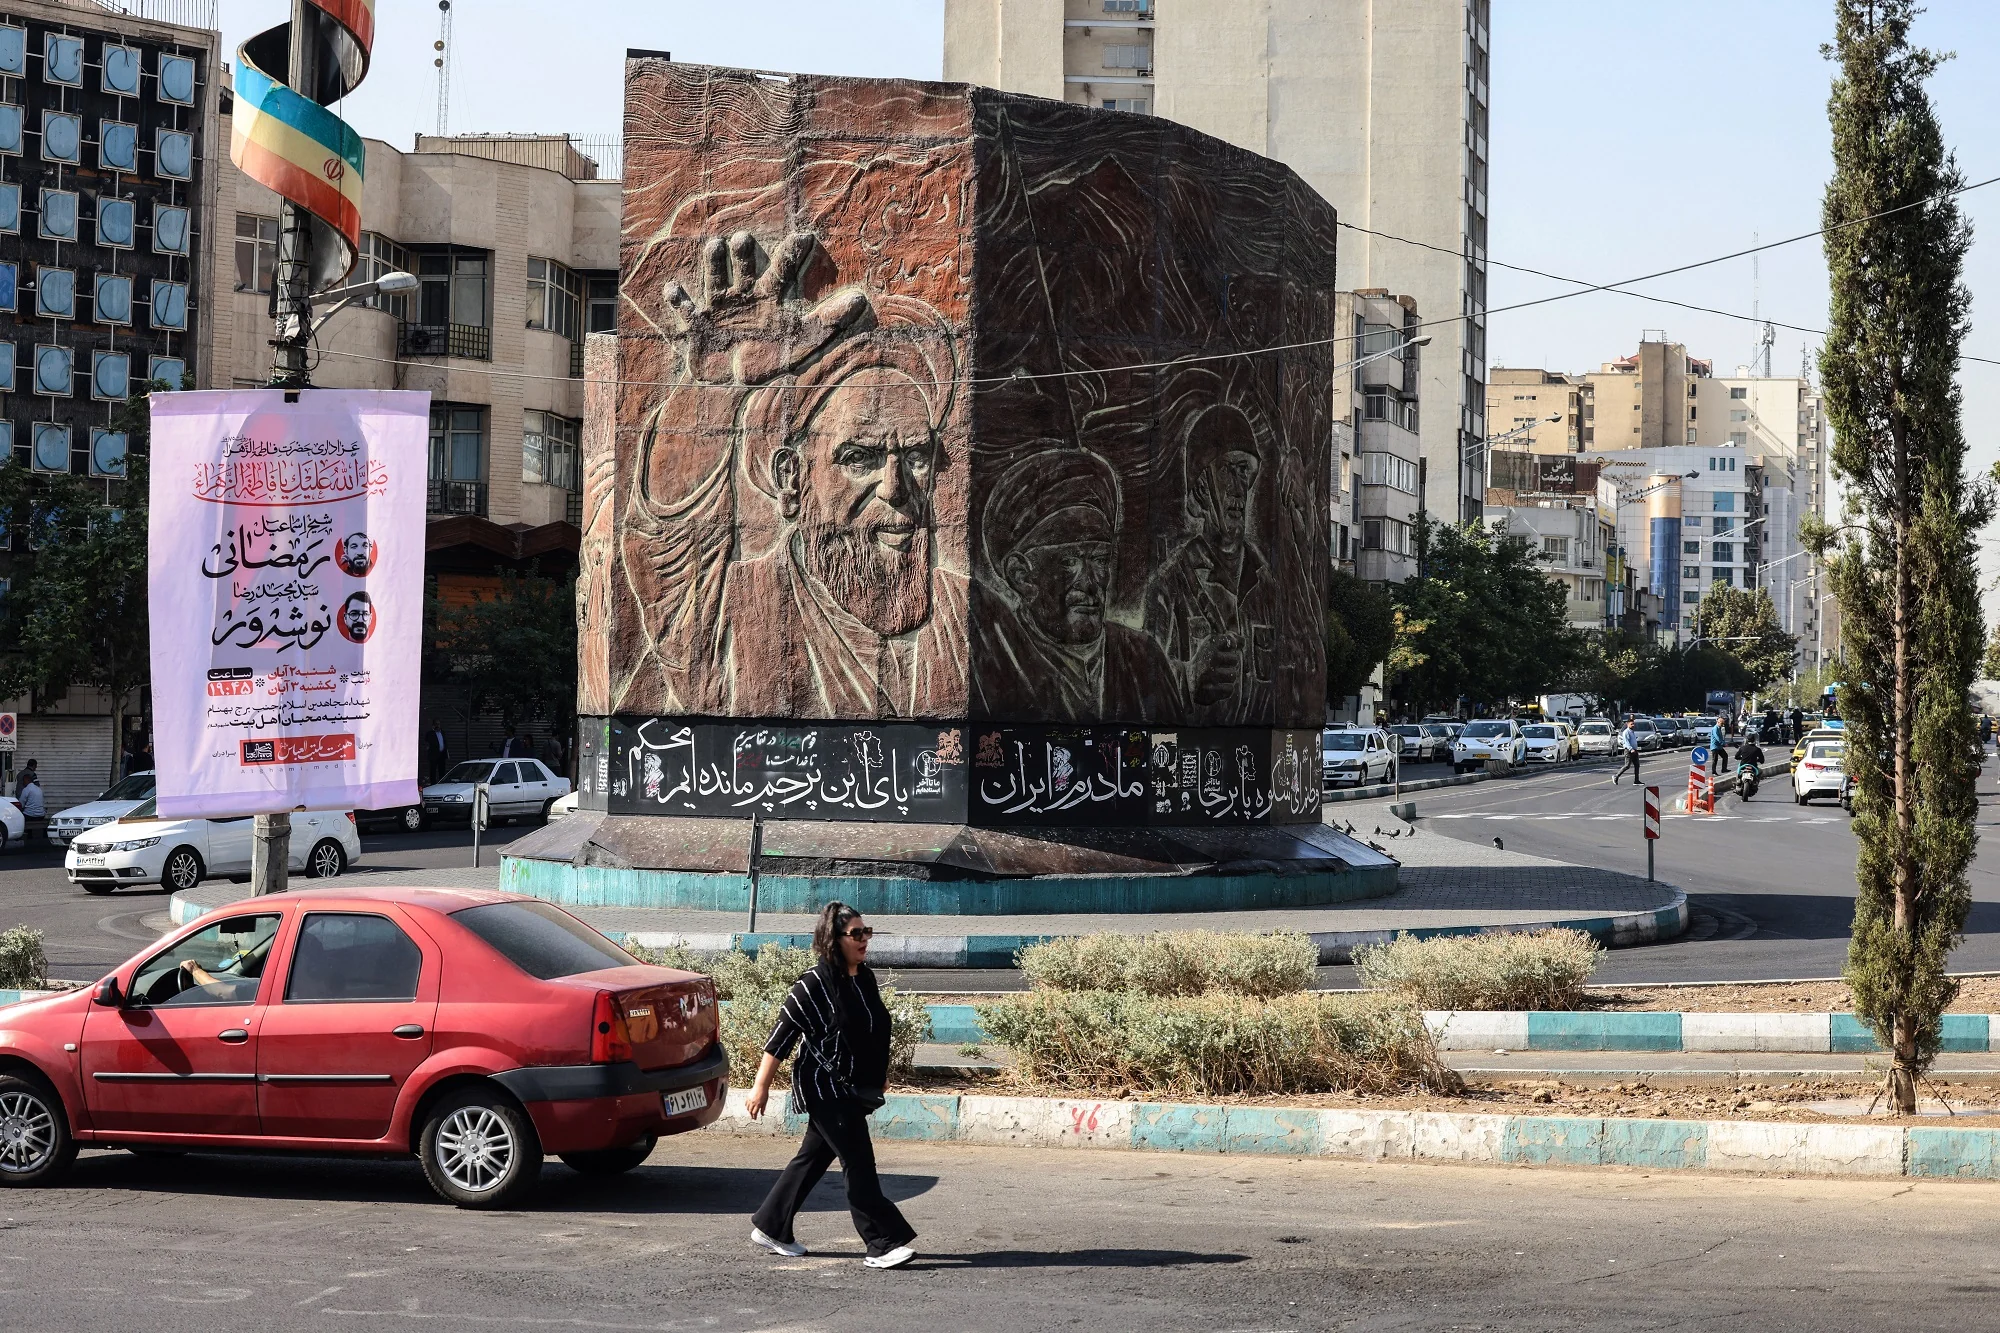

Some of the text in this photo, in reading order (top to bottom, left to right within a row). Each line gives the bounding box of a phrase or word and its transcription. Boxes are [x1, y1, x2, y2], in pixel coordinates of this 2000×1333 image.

[278, 440, 313, 458] حضرت
[1552, 458, 1567, 472] آش
[1541, 472, 1574, 485] نیکوصفت
[253, 513, 333, 537] شیخ اسماعیل
[201, 524, 331, 579] رمضانی
[209, 668, 252, 680] ساعت
[267, 664, 337, 680] شنبه ۲ آبان
[209, 681, 250, 696] ۱۹:۴۵
[267, 680, 337, 696] یکشنبه ۳ آبان
[207, 705, 233, 718] بهنام
[235, 706, 251, 717] برج
[252, 704, 280, 714] جنب
[229, 717, 256, 729] بیت
[255, 713, 281, 729] اهل
[281, 713, 322, 727] محبان
[322, 712, 371, 725] حسینیه
[277, 734, 353, 761] هیئت مکتب العباس
[767, 735, 777, 746] در
[796, 755, 809, 767] خدا
[809, 753, 818, 766] تا
[979, 741, 1053, 815] ایران
